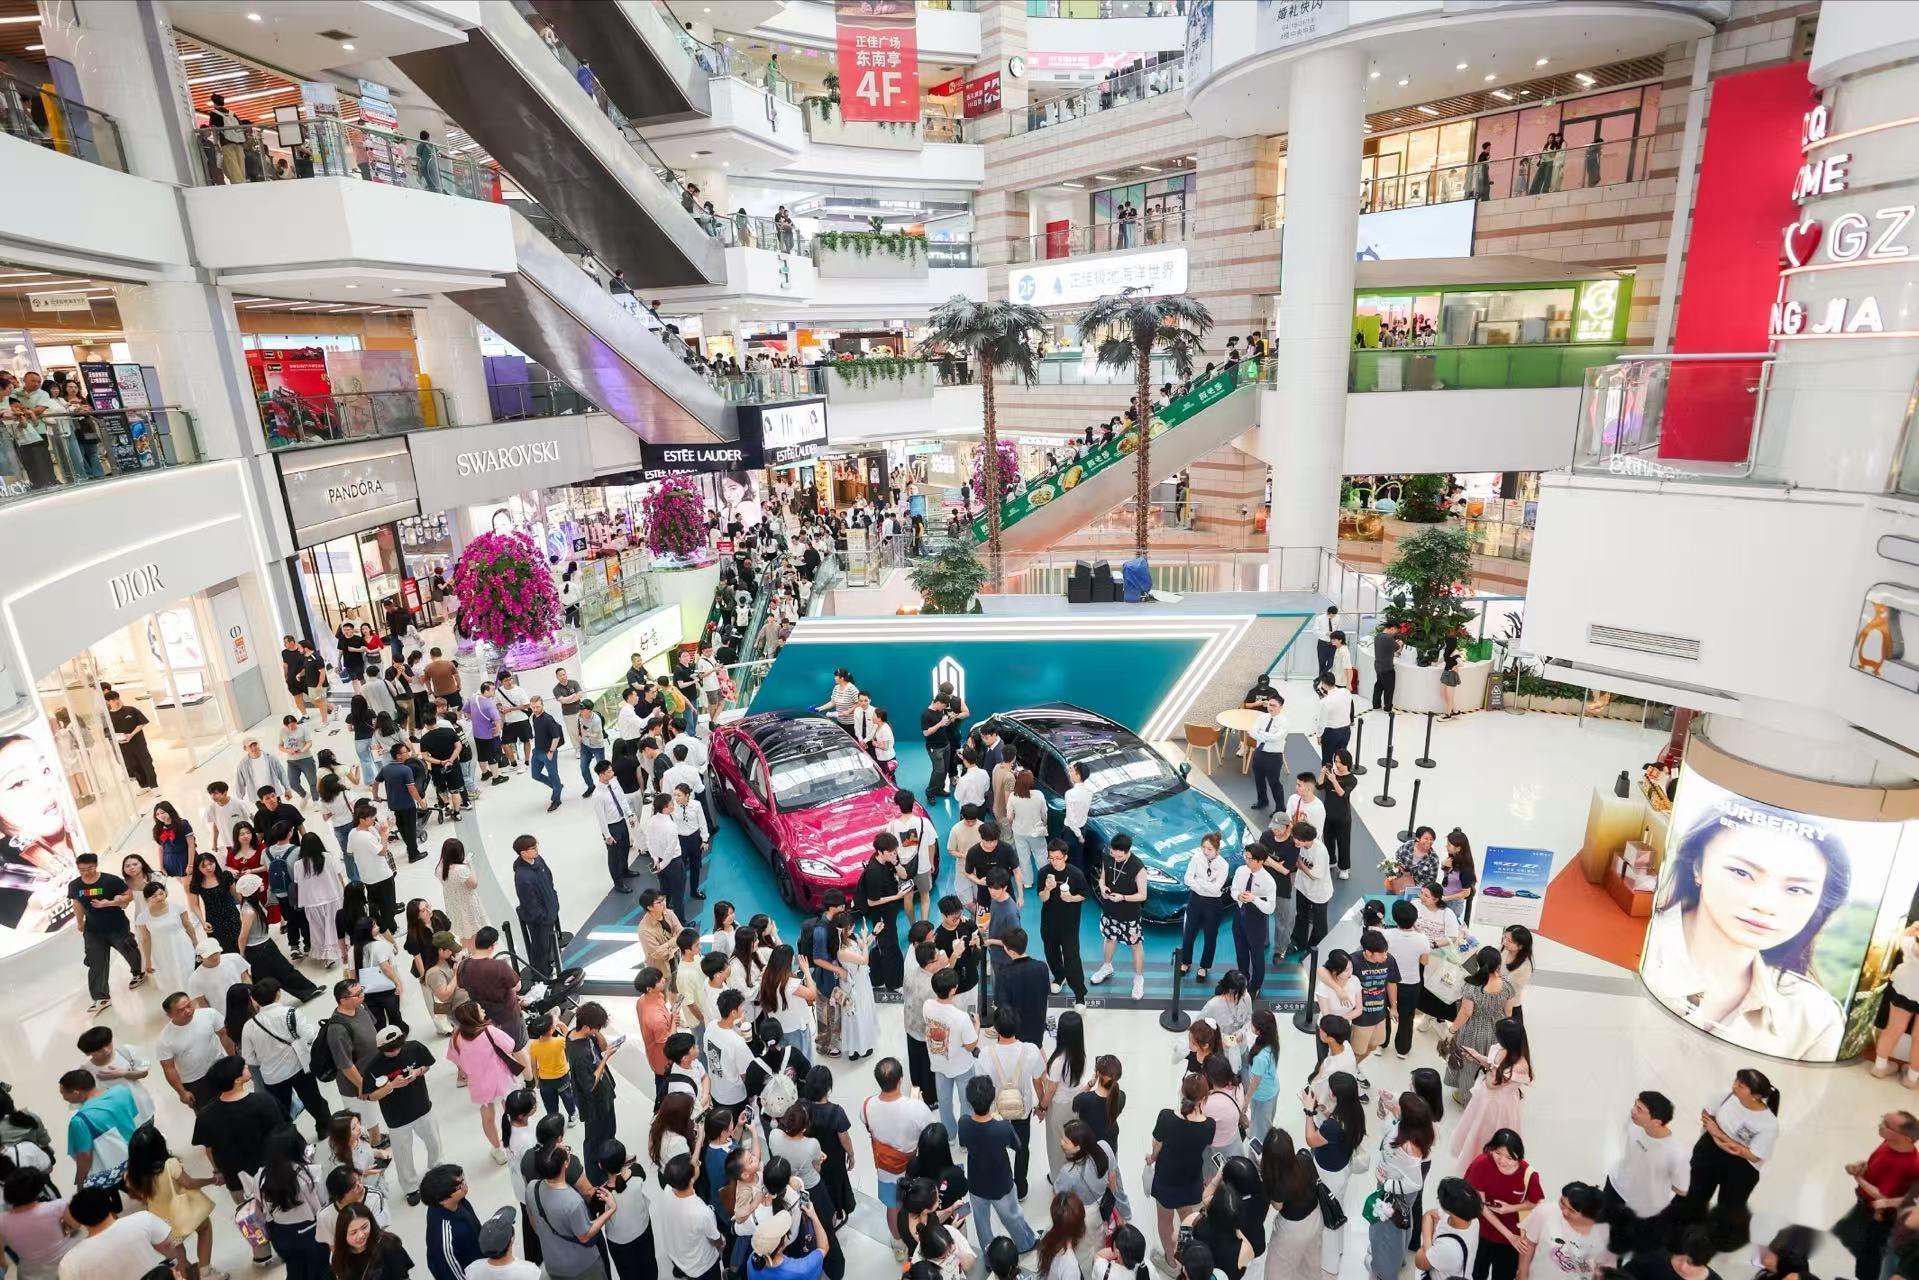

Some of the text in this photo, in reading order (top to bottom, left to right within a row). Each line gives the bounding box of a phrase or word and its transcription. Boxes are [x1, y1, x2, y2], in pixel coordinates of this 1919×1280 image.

[856, 36, 901, 49] 正佳广场
[856, 51, 901, 67] 东南亭
[856, 71, 902, 107] 4F
[456, 440, 561, 477] SWAROVSKI
[697, 450, 743, 462] LAUDER
[328, 479, 384, 504] PANDORA
[108, 562, 166, 610] DIOR
